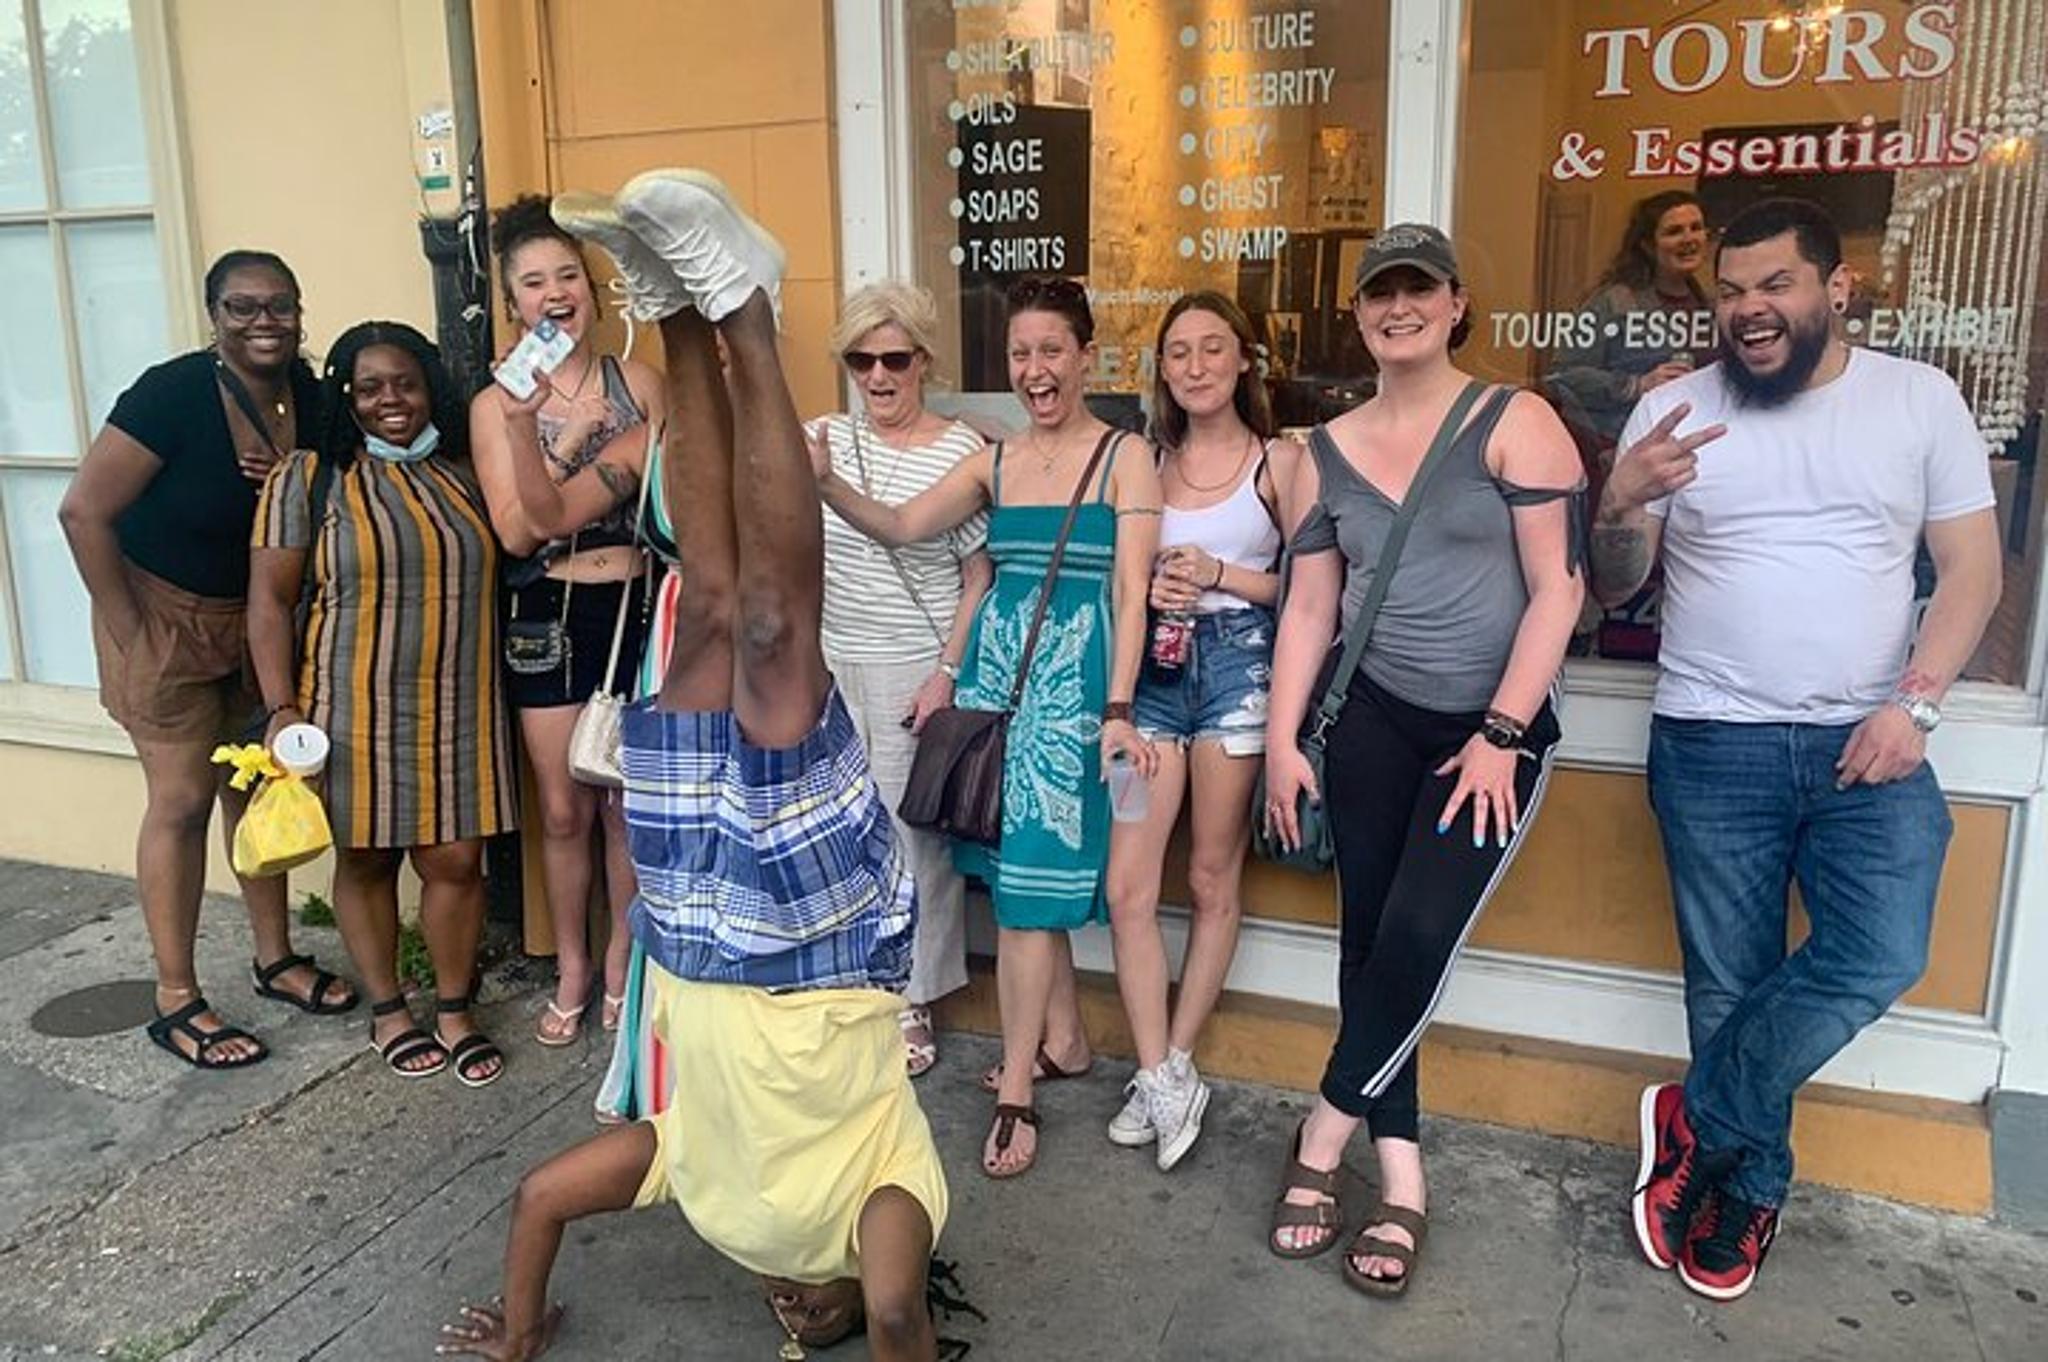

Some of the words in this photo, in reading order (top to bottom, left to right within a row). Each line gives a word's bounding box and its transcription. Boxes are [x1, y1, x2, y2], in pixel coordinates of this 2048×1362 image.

[1205, 10, 1316, 53] CULTURE
[1583, 3, 1958, 99] TOURS
[965, 38, 1024, 76] SHEA
[1028, 31, 1116, 72] BUTTER
[1200, 66, 1336, 111] CELEBRITY
[966, 91, 1017, 127] OILS
[971, 138, 1044, 175] SAGE
[1204, 123, 1268, 161] CITY
[1551, 130, 1605, 181] &
[1627, 110, 1982, 178] Essentials
[968, 187, 1040, 223] SOAPS
[1200, 174, 1284, 213] GHOST
[969, 235, 1066, 272] T-SHIRTS
[1200, 226, 1288, 263] SWAMP
[1490, 310, 1597, 349] TOURS
[1868, 306, 2018, 349] EXHIBIT
